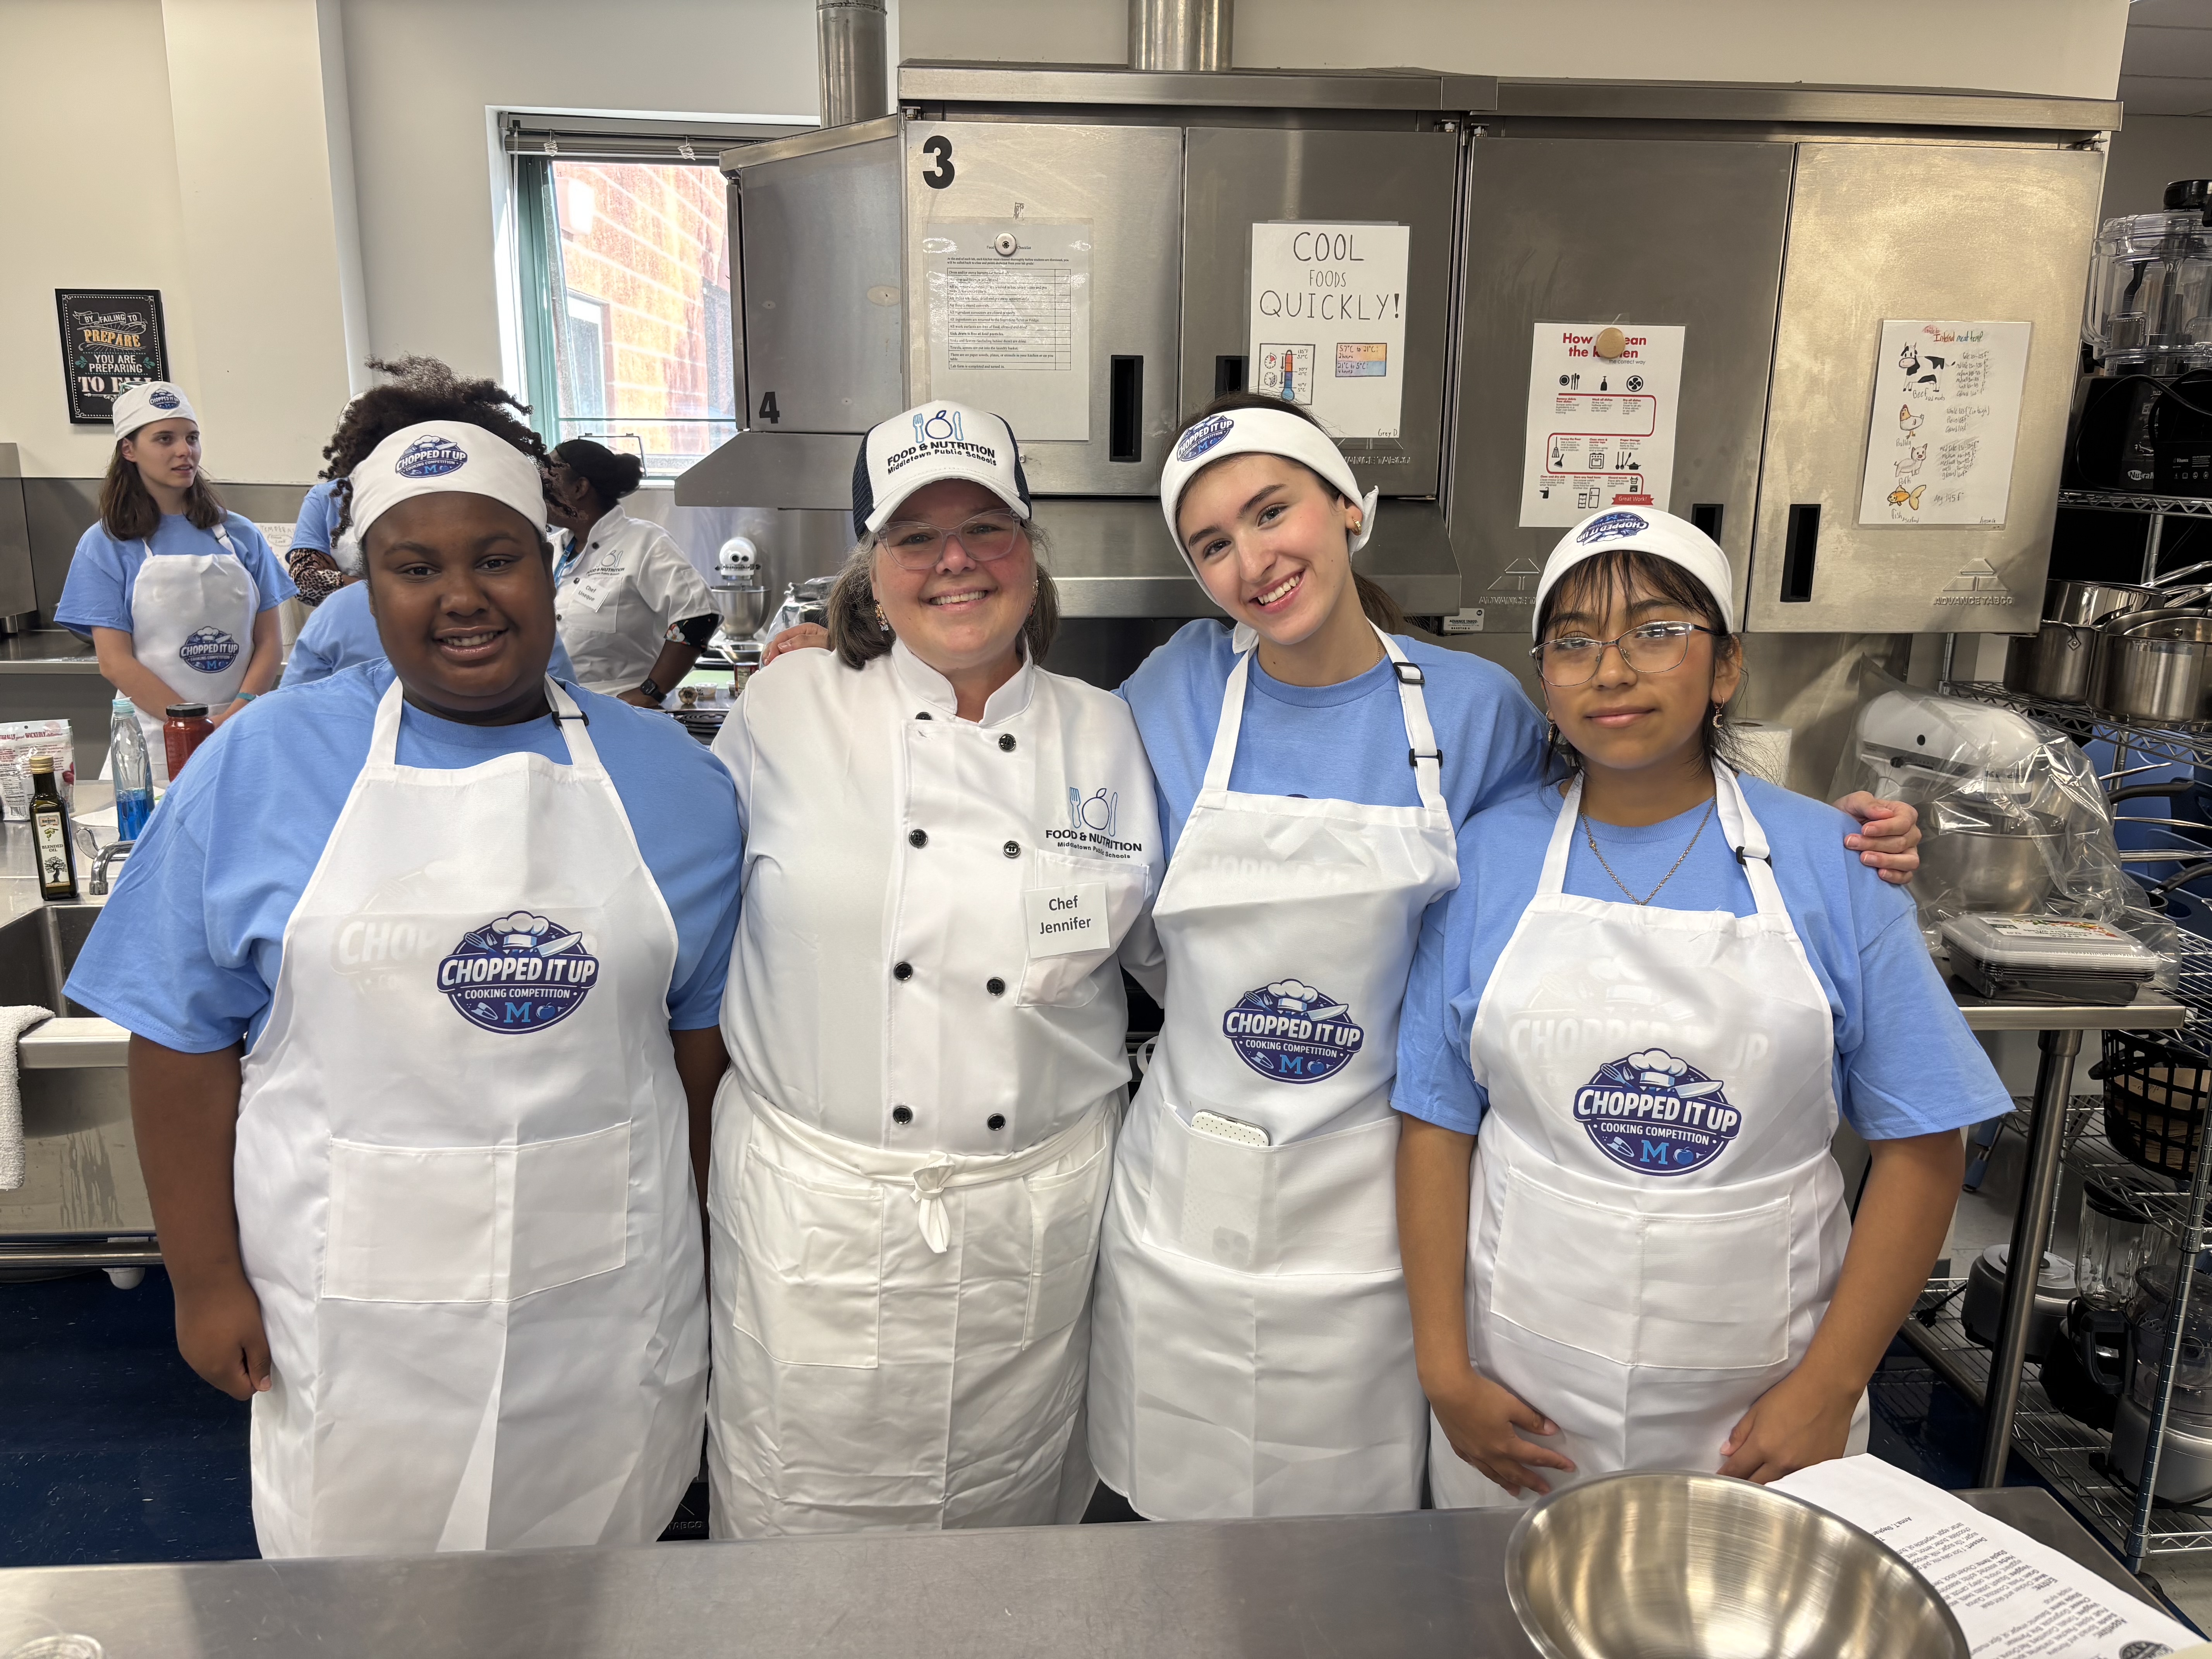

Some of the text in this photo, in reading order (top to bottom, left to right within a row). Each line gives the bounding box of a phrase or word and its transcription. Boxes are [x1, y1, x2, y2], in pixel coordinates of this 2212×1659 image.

[922, 135, 955, 189] 3
[1293, 232, 1364, 261] COOL
[1310, 270, 1346, 287] FOODS
[1260, 290, 1399, 320] QUICKLY!
[100, 314, 125, 323] FAILING
[83, 329, 141, 347] PREPARE
[1563, 333, 1647, 345] How ean
[94, 354, 136, 364] YOU ARE
[1569, 345, 1589, 357] the
[89, 364, 143, 373] PREPARING
[78, 376, 105, 393] TO
[759, 392, 780, 424] 4
[1178, 420, 1233, 458] CHOPPED IT UP
[1378, 428, 1391, 437] Grey
[396, 450, 466, 472] CHOPPED IT UP
[887, 447, 917, 467] FOOD
[931, 441, 995, 459] NUTRITION
[405, 462, 424, 471] COOKING
[423, 465, 438, 474] M
[888, 451, 931, 475] Middletown
[966, 451, 997, 466] Schools
[1589, 527, 1600, 536] IT
[1600, 522, 1647, 532] CHOPPED
[1577, 532, 1589, 542] UP
[586, 585, 597, 594] Chef
[1934, 596, 2014, 605] ADVANCE TABCO
[180, 644, 238, 657] CHOPPED IT UP
[207, 660, 217, 669] M
[1046, 829, 1142, 852] FOOD & NUTRITION
[1057, 841, 1131, 859] Middletown Public Schools
[1049, 895, 1078, 911] Chef
[1040, 916, 1091, 935] Jennifer
[441, 957, 596, 986] CHOPPED IT UP
[465, 988, 570, 1000] COOKING COMPETITION
[503, 1001, 532, 1023] M
[1226, 1011, 1361, 1048] CHOPPED IT UP
[1245, 1039, 1338, 1058] COOKING COMPETITION
[1279, 1054, 1303, 1075] M
[1578, 1089, 1738, 1133] CHOPPED IT UP
[1601, 1122, 1709, 1145] COOKING COMPETITION
[1640, 1139, 1669, 1165] M
[1963, 1537, 1988, 1549] Dessert:
